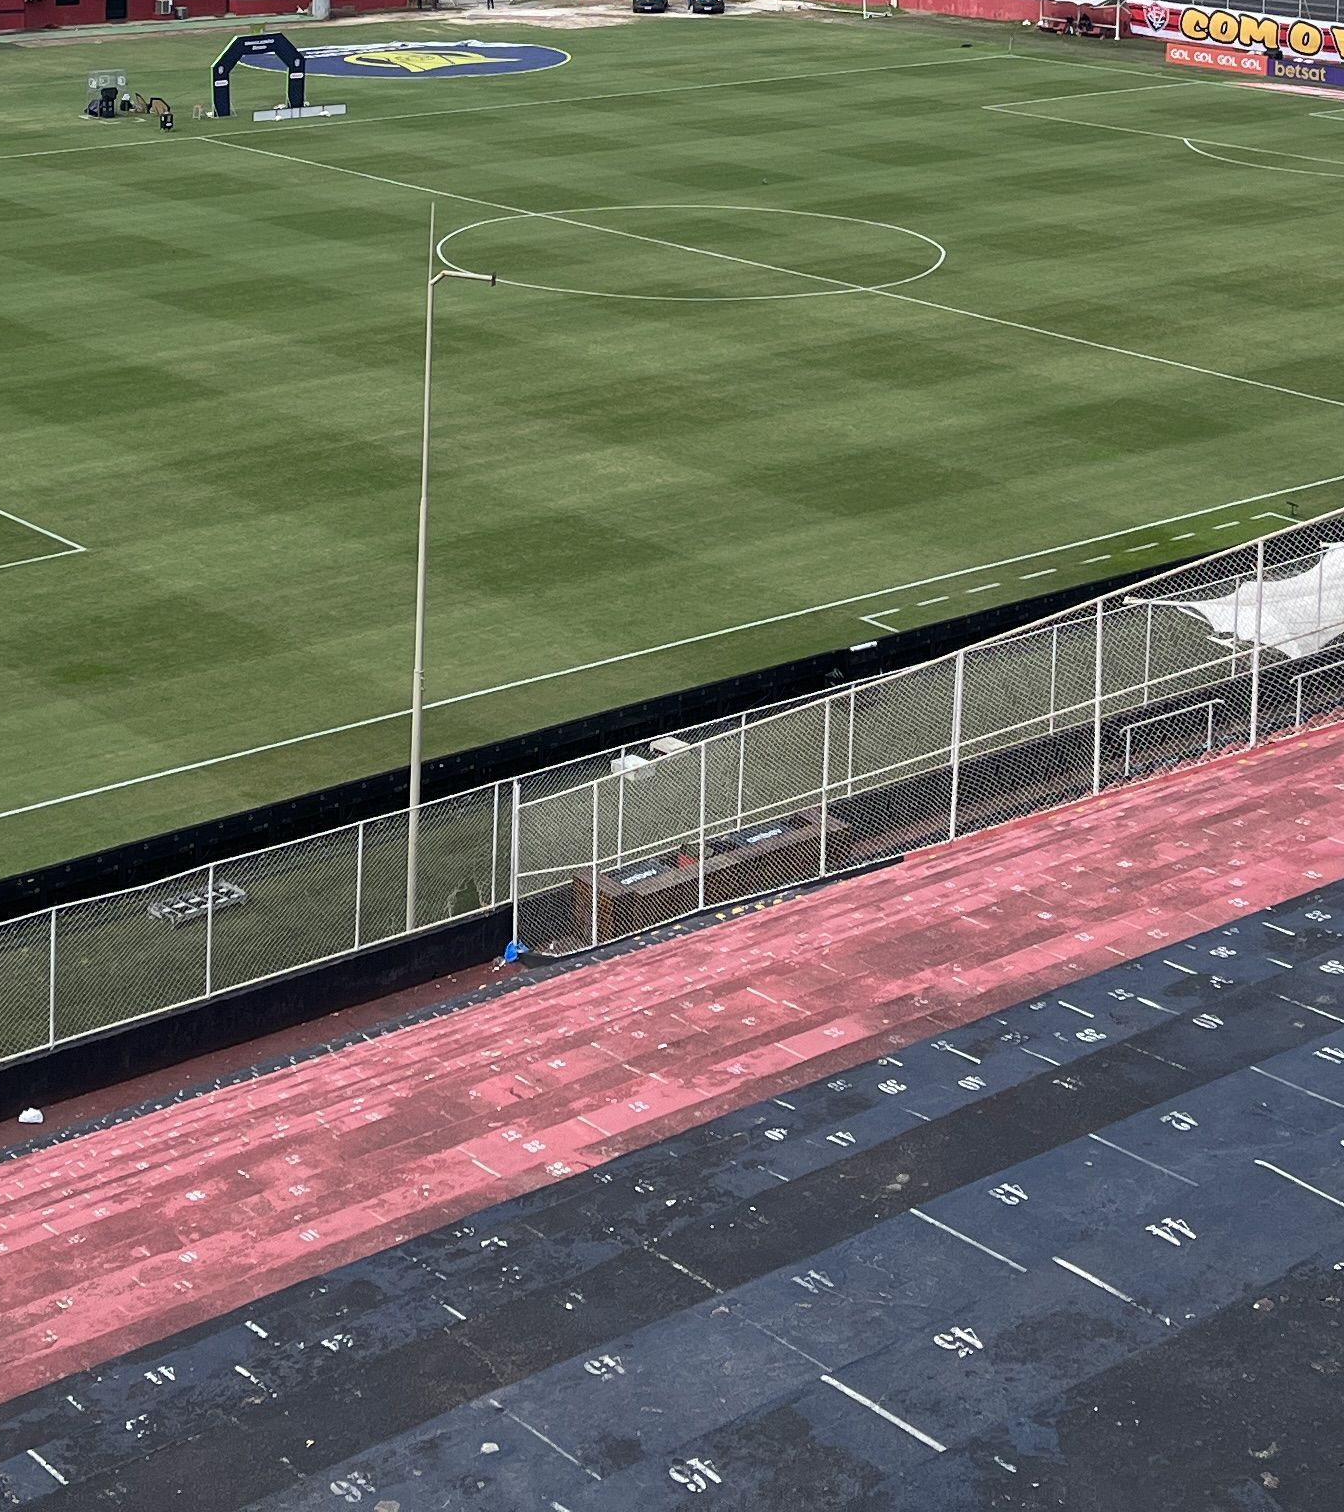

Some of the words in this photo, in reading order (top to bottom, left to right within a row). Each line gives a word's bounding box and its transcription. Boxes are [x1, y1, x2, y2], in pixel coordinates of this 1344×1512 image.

[1180, 8, 1279, 50] COM
[1288, 20, 1323, 55] O
[1170, 48, 1190, 61] GOL
[1194, 51, 1213, 64] GOL
[1217, 54, 1237, 67] GOL
[1241, 57, 1262, 71] GOL
[1274, 61, 1327, 82] betsat
[1192, 1013, 1224, 1029] 40
[877, 1079, 907, 1095] 39
[957, 1075, 987, 1091] 40
[1160, 1110, 1199, 1131] 42
[825, 1131, 857, 1147] 41
[988, 1183, 1029, 1205] 43
[1144, 1217, 1197, 1247] 44
[933, 1326, 984, 1358] 45
